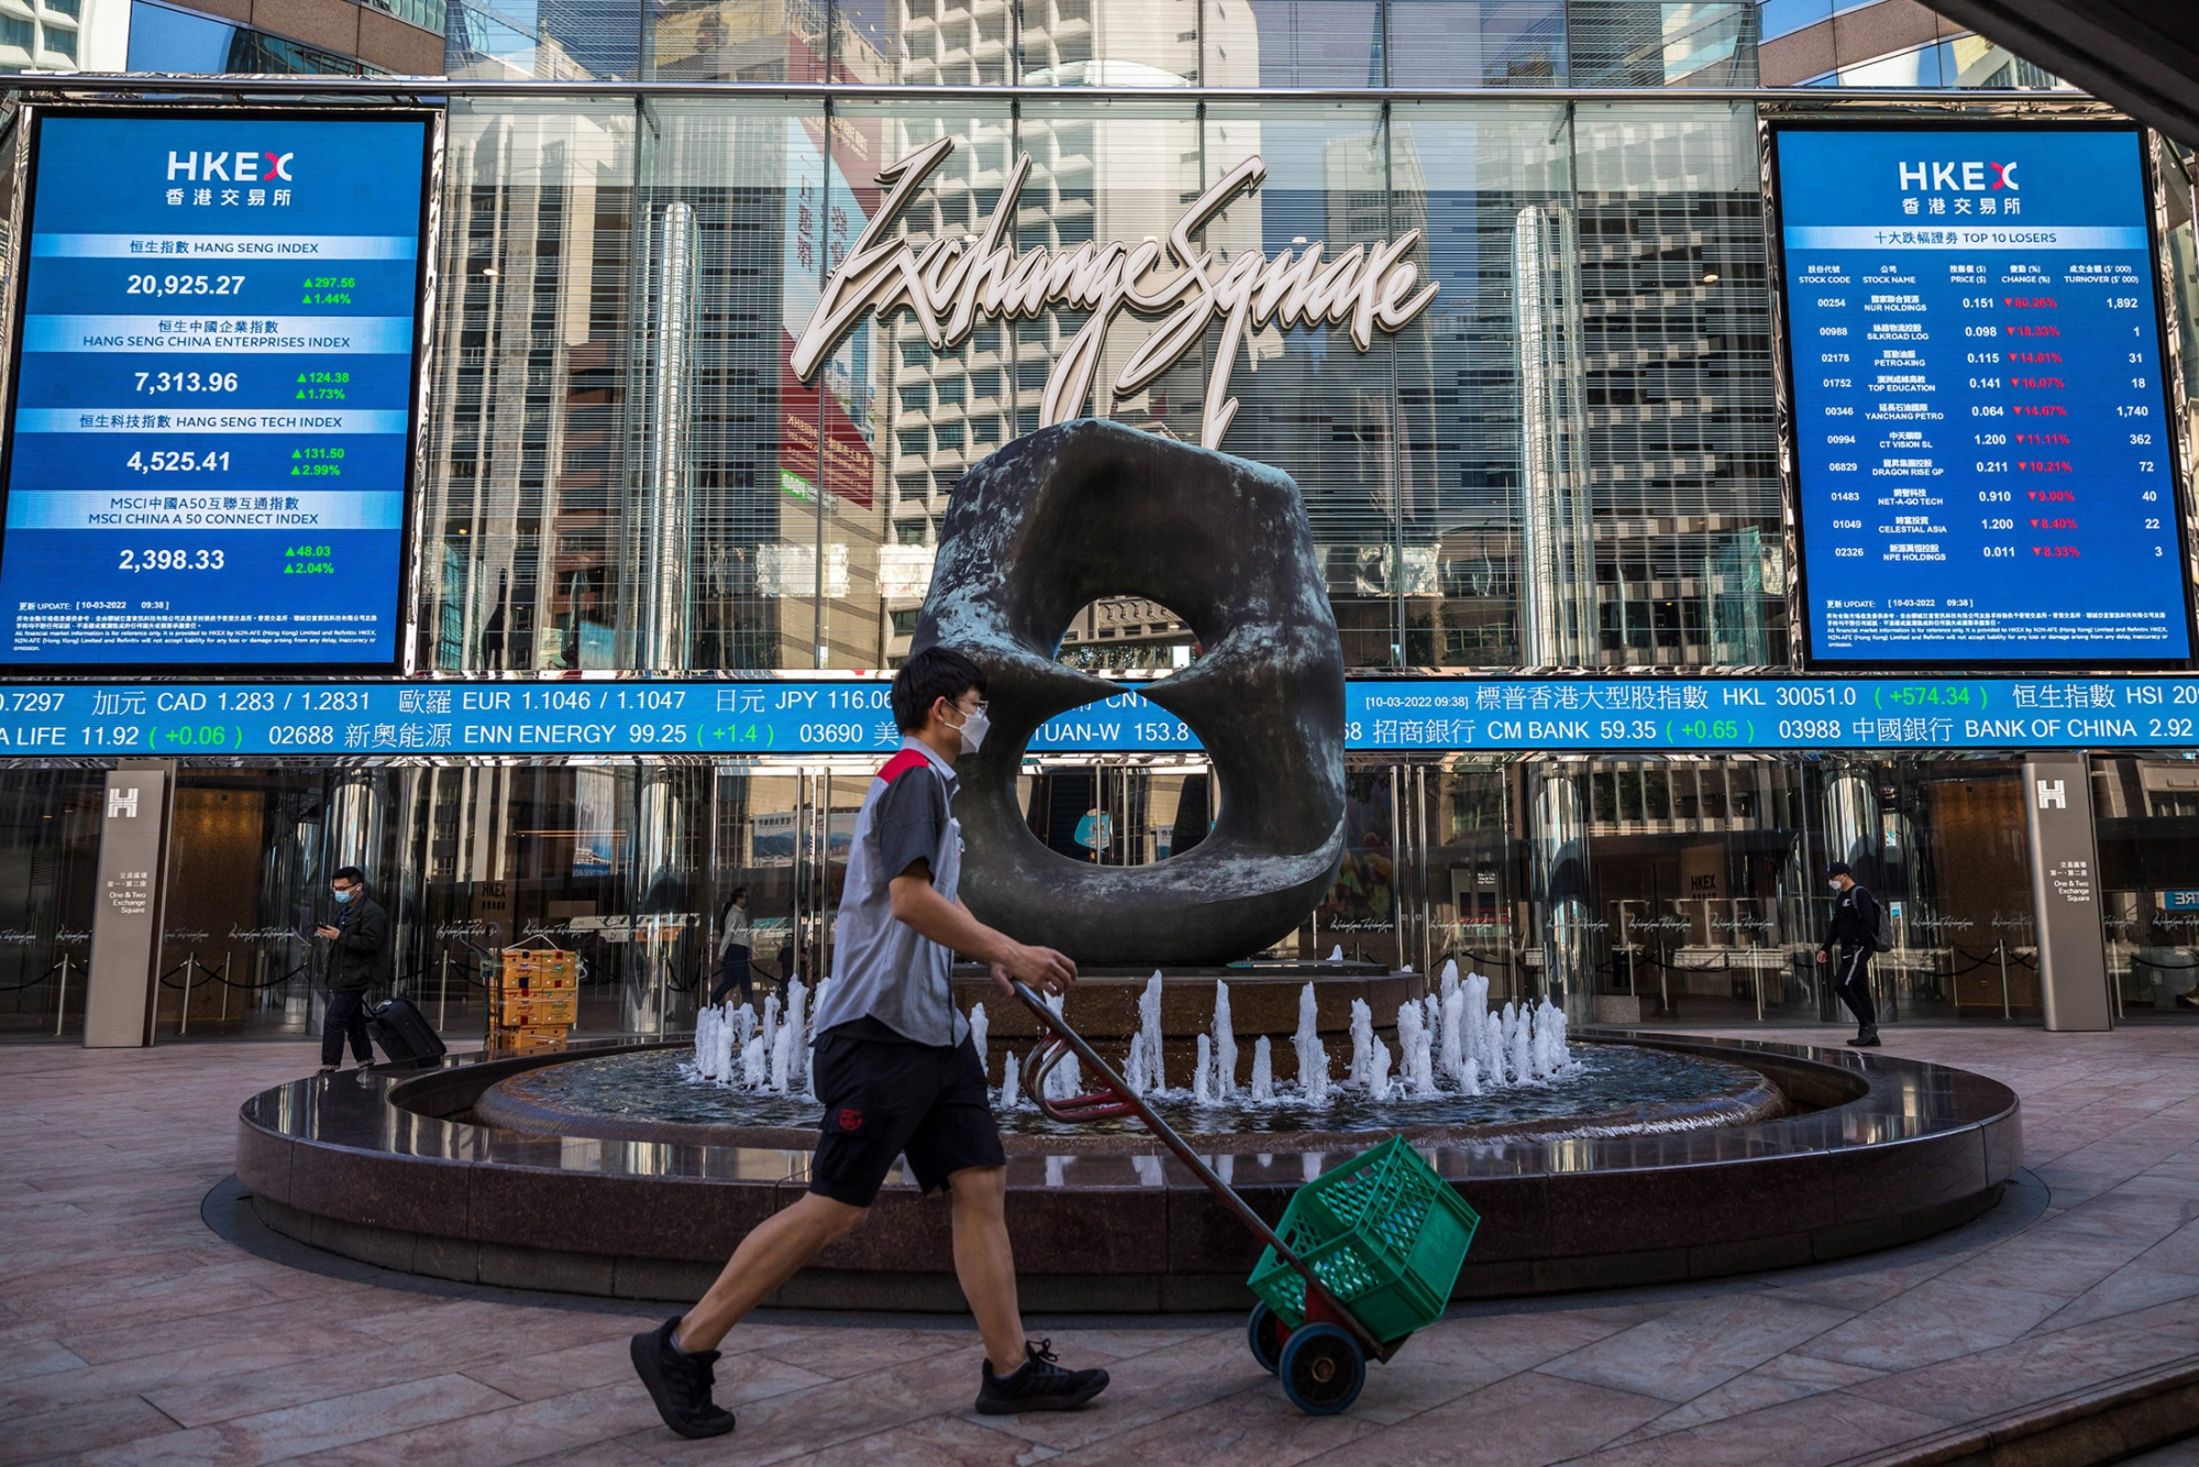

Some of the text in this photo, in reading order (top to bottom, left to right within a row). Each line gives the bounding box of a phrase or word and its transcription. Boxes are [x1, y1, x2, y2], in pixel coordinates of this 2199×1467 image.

[167, 151, 293, 181] HKEX
[1899, 162, 2019, 190] HKEX
[166, 188, 291, 206] 香港交易所
[1903, 198, 2020, 214] 香港交易所
[1963, 233, 1988, 242] TOP
[1992, 233, 2006, 242] 10
[2009, 233, 2056, 242] LOSERS
[130, 240, 318, 253] 恒生指數 HANG SENG INDEX
[127, 275, 245, 297] 20,925.27
[313, 277, 355, 288] 297.56
[790, 135, 1440, 450] Exchange Square
[315, 293, 351, 304] 1.44%
[1818, 299, 1845, 307] 00254
[1963, 298, 1993, 308] 0.151
[2107, 298, 2138, 309] 1,892
[158, 320, 278, 333] 恒生中國企業指數
[1820, 327, 1847, 335] 00988
[1965, 327, 1997, 336] 0.098
[2134, 327, 2139, 336] 1
[83, 336, 350, 347] HANG SENG CHINA ENTERPRISES INDEX
[1822, 354, 1849, 362] 02178
[1967, 353, 1999, 363] 0.115
[2129, 353, 2142, 363] 31
[310, 372, 349, 383] 124.38
[135, 372, 237, 394] 7,313.96
[1823, 379, 1851, 387] 01752
[1970, 378, 2000, 388] 0.141
[2132, 378, 2145, 388] 18
[309, 388, 345, 399] 1.73%
[1825, 407, 1853, 415] 00346
[1972, 406, 2004, 416] 0.064
[2117, 406, 2148, 417] 1,740
[79, 414, 342, 428] 恒生科技指數 HANG SENG TECH INDEX
[1827, 435, 1855, 444] 00994
[1975, 434, 2006, 444] 1.200
[2130, 434, 2151, 444] 362
[304, 448, 345, 458] 131.50
[127, 452, 229, 474] 4,525.41
[1977, 462, 2007, 472] 0.211
[2139, 462, 2154, 472] 72
[302, 464, 340, 475] 2.99%
[1831, 492, 1859, 501] 01483
[1979, 491, 2011, 501] 0.910
[2142, 491, 2156, 501] 40
[111, 497, 299, 510] MSCI中國A50互聯互通指數
[89, 514, 318, 524] MSCI CHINA A 50 CONNECT INDEX
[1833, 520, 1861, 528] 01049
[1982, 519, 2013, 529] 1.200
[2145, 519, 2160, 529] 22
[297, 546, 331, 556] 48.03
[1835, 548, 1864, 556] 02326
[1984, 547, 2014, 557] 0.011
[2155, 546, 2162, 556] 3
[119, 550, 224, 573] 2,398.33
[296, 563, 334, 573] 2.04%
[91, 690, 146, 715] 加元
[158, 693, 206, 711] CAD
[219, 692, 274, 711] 1.283
[302, 692, 368, 710] 1.2831
[399, 690, 451, 714] 歐羅
[463, 692, 510, 709] EUR
[523, 691, 590, 709] 1.1046
[618, 691, 685, 709] 1.1047
[717, 689, 765, 713] 日元
[775, 691, 818, 709] JPY
[1476, 685, 1708, 710] 標普香港大型股指數
[1723, 688, 1766, 705] HKL
[1776, 687, 1856, 705] 30051.0
[2013, 684, 2116, 708] 恒生指數
[2127, 686, 2162, 704] HSI
[1366, 697, 1432, 710] [10-03-2022
[17, 727, 66, 745] LIFE
[82, 727, 139, 745] 11.92
[269, 726, 333, 744] 02688
[344, 723, 452, 748] 新奧能源
[465, 726, 512, 743] ENN
[520, 725, 616, 743] ENERGY
[630, 724, 686, 743] 99.25
[800, 724, 863, 742] 03690
[874, 720, 899, 746] 美
[1134, 721, 1190, 741] 153.8
[1373, 719, 1476, 744] 招商銀行
[1488, 721, 1521, 739] CM
[1529, 721, 1590, 738] BANK
[1601, 720, 1656, 739] 59.35
[1779, 720, 1841, 738] 03988
[1853, 718, 1953, 742] 中國銀行
[1966, 720, 2026, 737] BANK
[2032, 719, 2060, 737] OF
[2068, 719, 2137, 737] CHINA
[2149, 719, 2193, 737] 2.92
